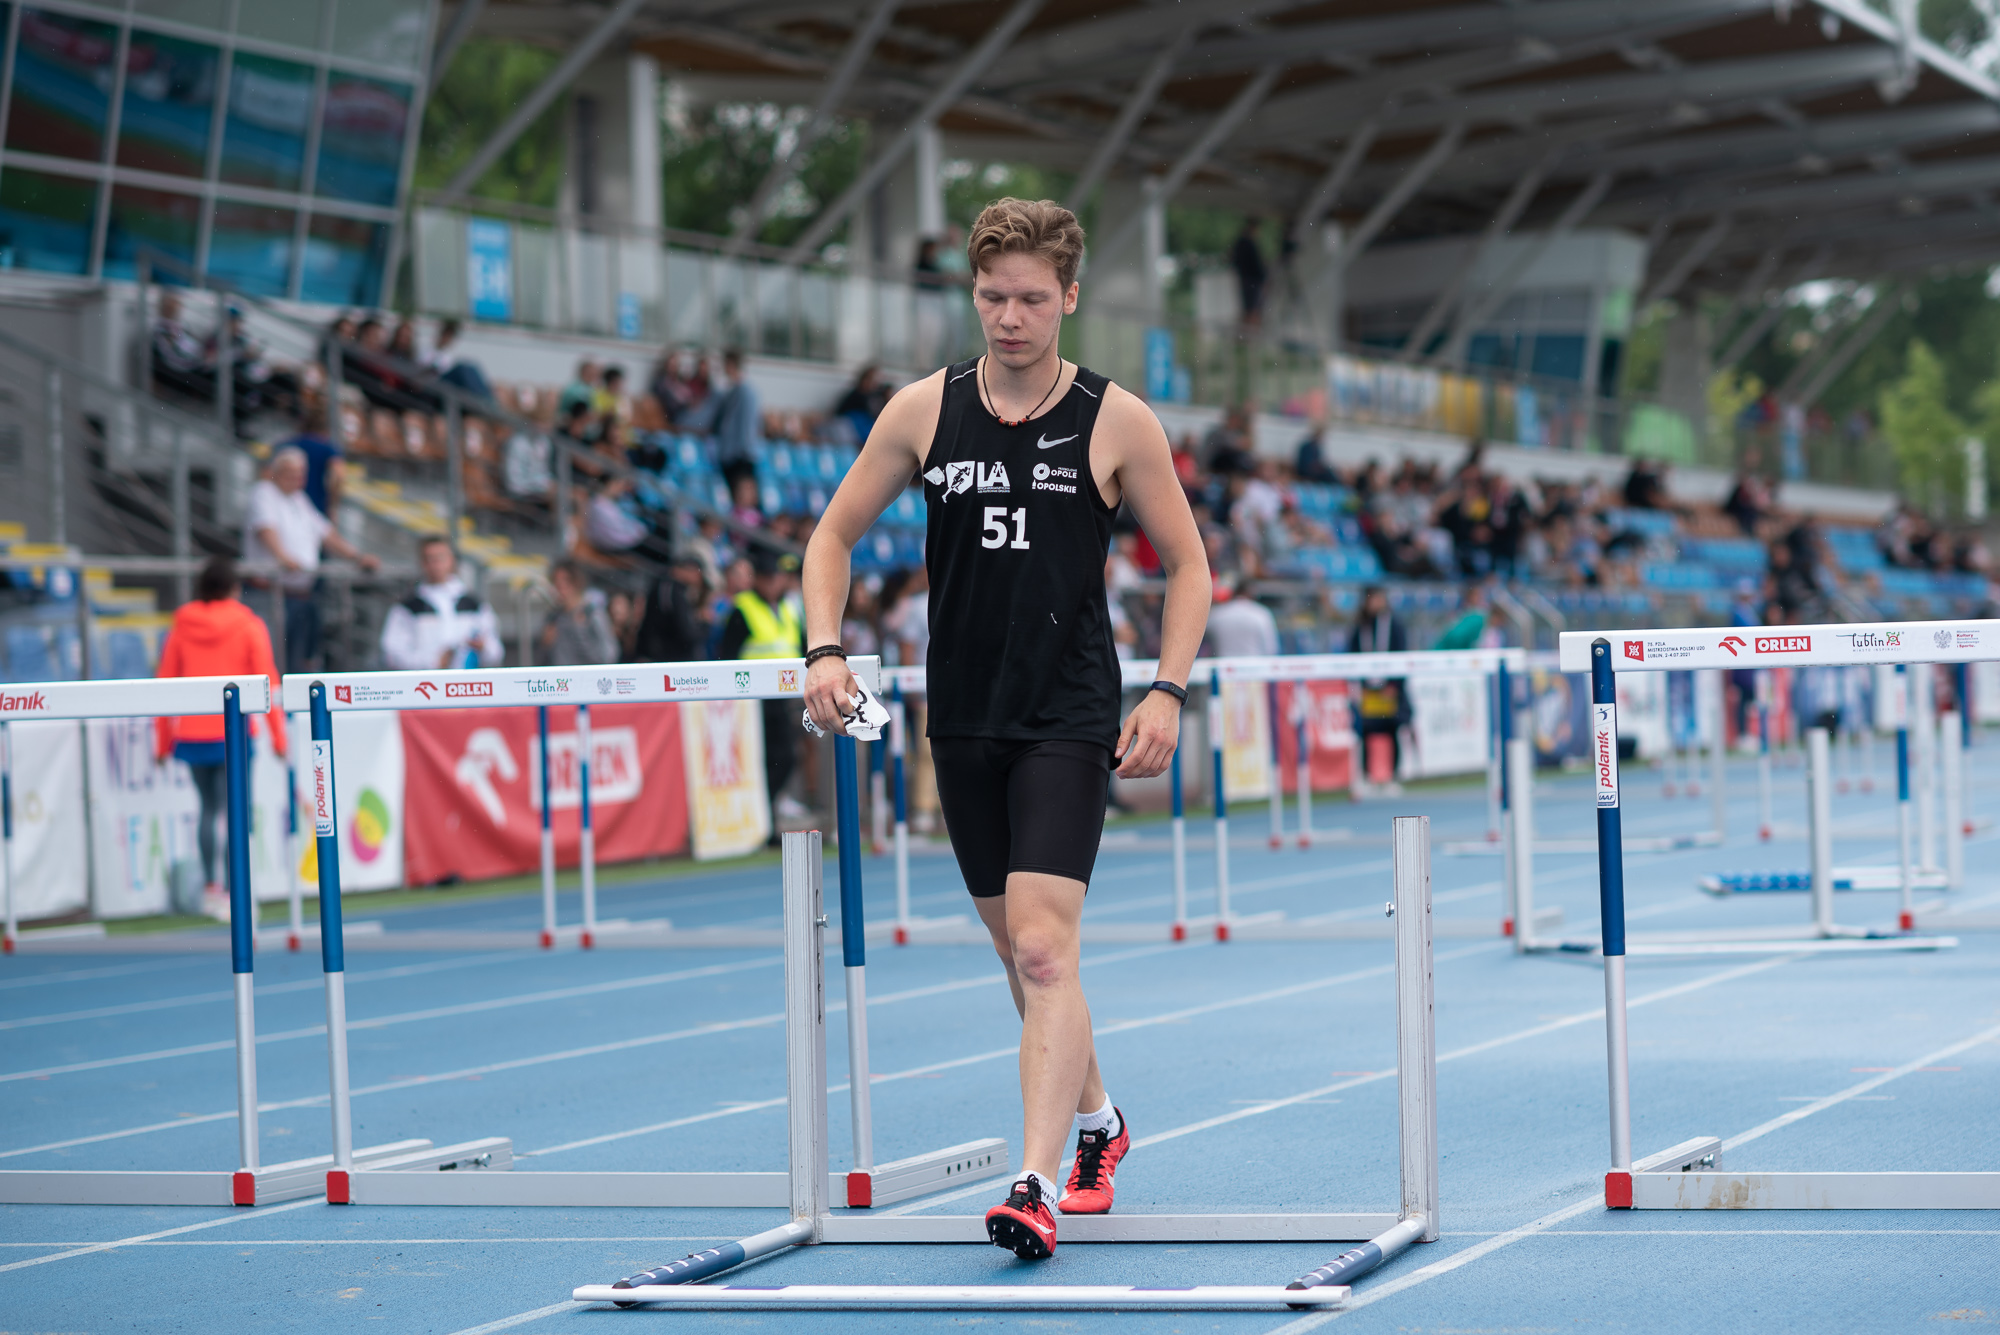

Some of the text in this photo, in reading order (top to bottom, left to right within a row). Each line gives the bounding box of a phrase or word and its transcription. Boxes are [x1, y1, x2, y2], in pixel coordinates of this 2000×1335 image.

[1051, 469, 1077, 479] OPOLE
[1037, 482, 1077, 494] OPOLSKIE
[981, 506, 1030, 550] 51
[1757, 637, 1808, 651] ORLEN
[673, 676, 709, 686] lubelskie
[447, 683, 491, 697] ORLEN
[1597, 730, 1614, 788] polanik
[314, 765, 329, 819] polanik
